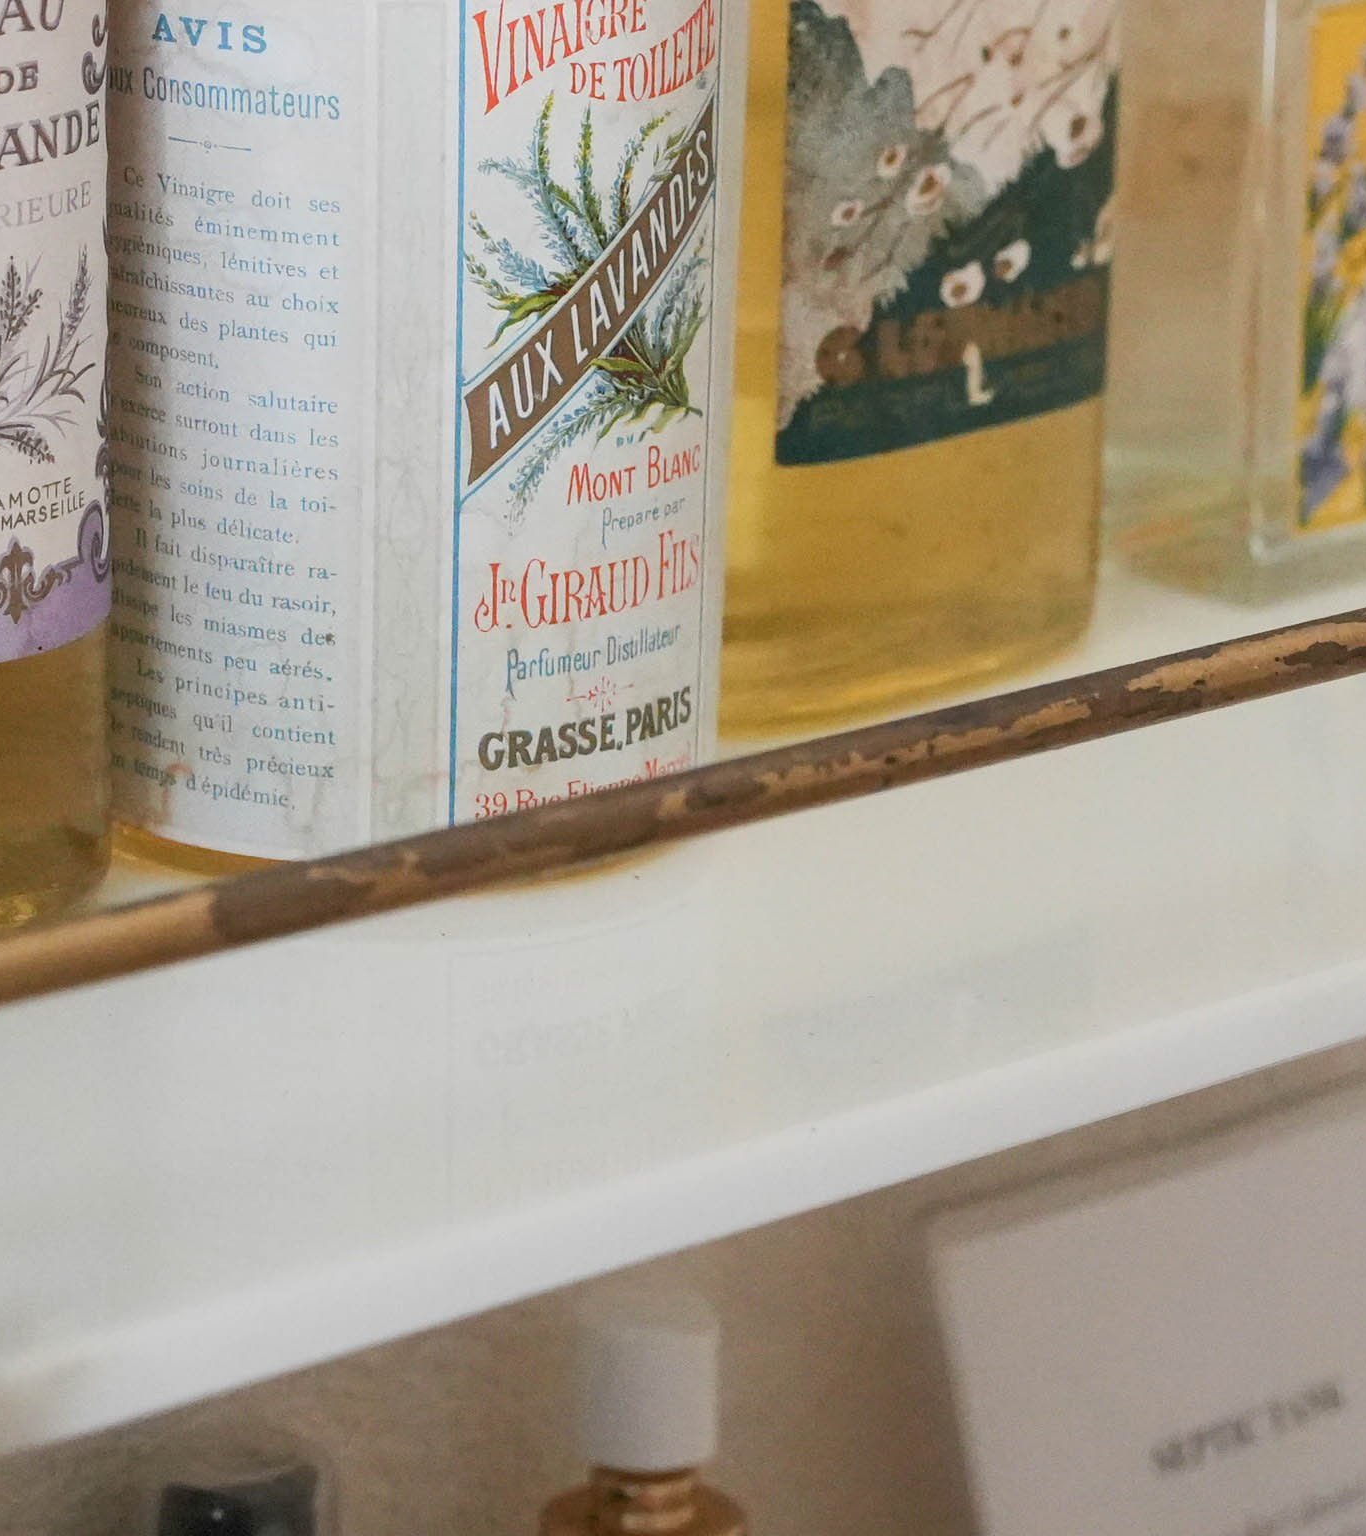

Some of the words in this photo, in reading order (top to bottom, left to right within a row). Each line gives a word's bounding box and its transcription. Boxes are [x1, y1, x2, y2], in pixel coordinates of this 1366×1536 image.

[152, 13, 267, 53] AVIS
[143, 66, 340, 120] Consommateurs
[569, 60, 606, 100] DE
[124, 167, 144, 187] Ce
[157, 173, 235, 206] Vinaigre
[251, 190, 291, 209] doit
[309, 198, 340, 214] ses
[194, 216, 339, 247] éminemment
[221, 251, 306, 278] lénitives
[319, 265, 340, 280] et
[246, 294, 270, 308] au
[282, 293, 339, 314] choix
[488, 329, 564, 449] AUX
[570, 130, 709, 365] LAVANDES
[179, 312, 208, 333] des
[219, 320, 289, 344] plantes
[304, 330, 338, 351] qui
[176, 380, 230, 403] action
[248, 391, 338, 414] salutaire
[175, 414, 238, 438] surtout
[250, 424, 296, 445] dans
[310, 429, 339, 448] les
[202, 448, 339, 481] journalières
[567, 463, 636, 506] MONT
[648, 444, 700, 489] BLANC
[150, 468, 171, 490] les
[180, 480, 223, 500] soins
[235, 488, 257, 506] de
[270, 491, 288, 510] la
[300, 494, 336, 513] toi-
[664, 497, 685, 518] par
[149, 500, 162, 521] la
[171, 509, 207, 531] plus
[217, 517, 299, 545] délicate.
[155, 534, 182, 558] fait
[190, 544, 296, 577] disparaître
[308, 564, 338, 580] ra-
[184, 575, 199, 594] le
[239, 588, 263, 607] du
[271, 593, 337, 616] rasoir,
[521, 557, 650, 629] GIRAUD
[171, 604, 192, 625] les
[203, 617, 287, 642] miasmes
[301, 627, 337, 647] des
[224, 653, 258, 673] peu
[269, 659, 333, 682] aérés.
[506, 648, 600, 700] Parfumeur
[607, 624, 681, 666] Distillateur
[137, 658, 163, 684] Les
[175, 676, 268, 706] principes
[279, 695, 336, 713] anti-
[132, 725, 185, 755] rendent
[199, 745, 232, 766] très
[246, 756, 335, 778] précieux
[252, 725, 337, 746] contient
